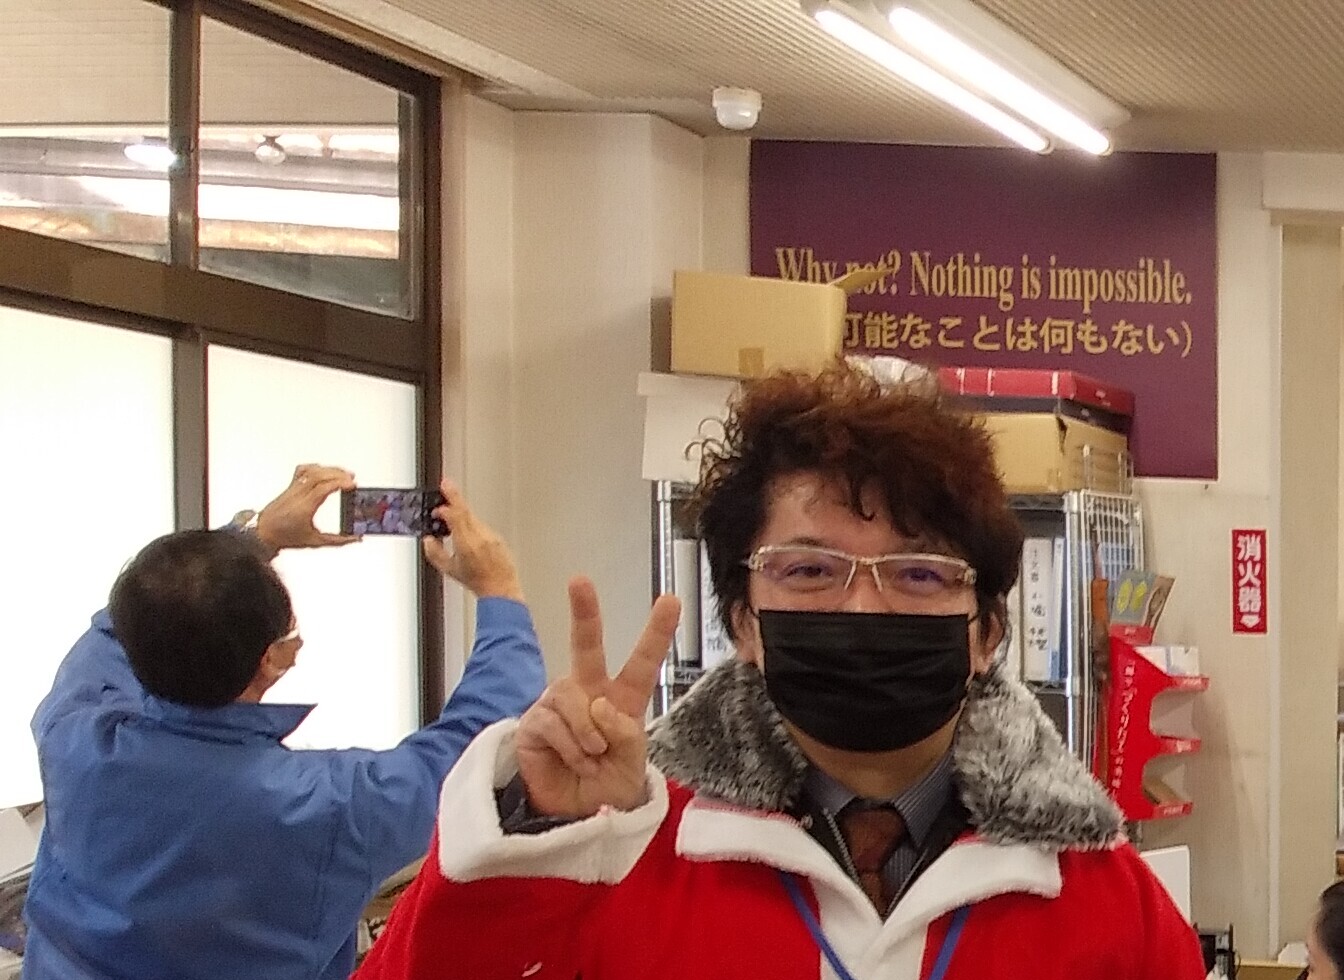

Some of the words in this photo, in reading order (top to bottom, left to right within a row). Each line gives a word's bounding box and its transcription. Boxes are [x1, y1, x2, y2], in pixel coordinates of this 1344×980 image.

[775, 247, 837, 284] Why
[910, 251, 1014, 312] Nothing
[1021, 255, 1041, 301] is
[1049, 255, 1192, 315] impossible.
[1237, 533, 1262, 613] 消火器
